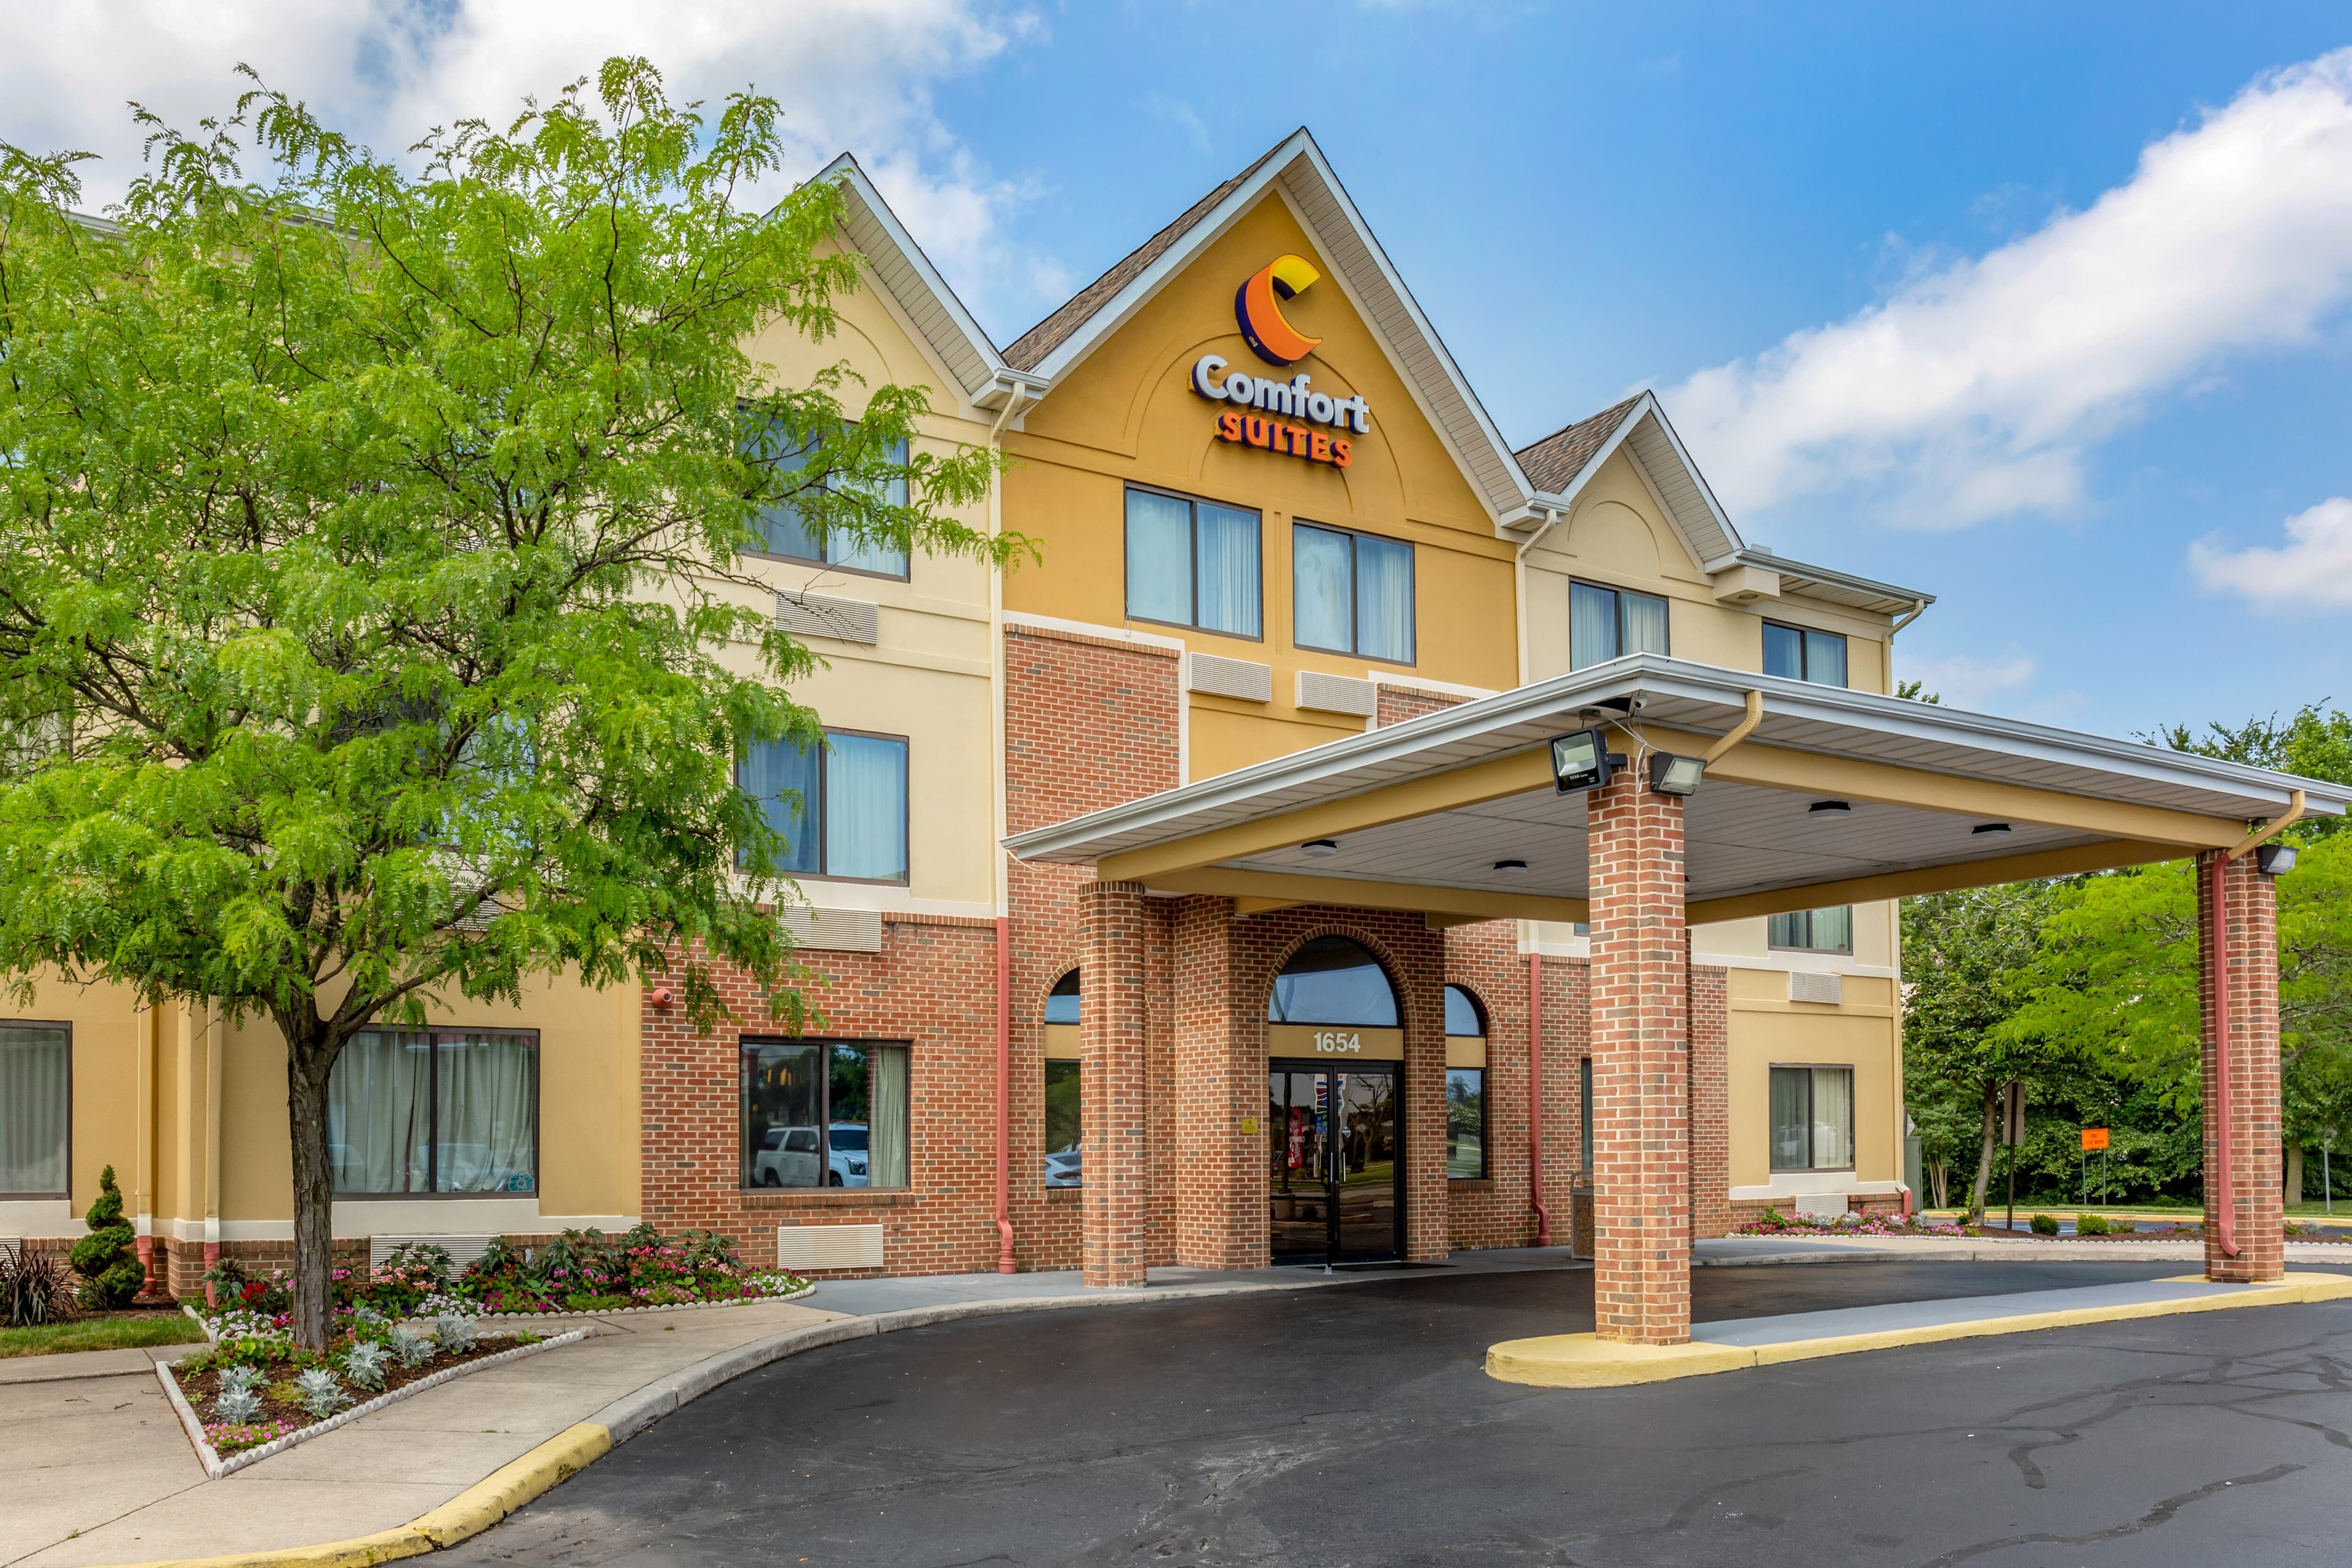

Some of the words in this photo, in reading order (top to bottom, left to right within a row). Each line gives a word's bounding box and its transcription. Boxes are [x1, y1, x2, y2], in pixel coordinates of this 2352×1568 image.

[1193, 353, 1370, 435] Comfort
[1219, 411, 1353, 468] SUITES
[1313, 1032, 1361, 1052] 1654
